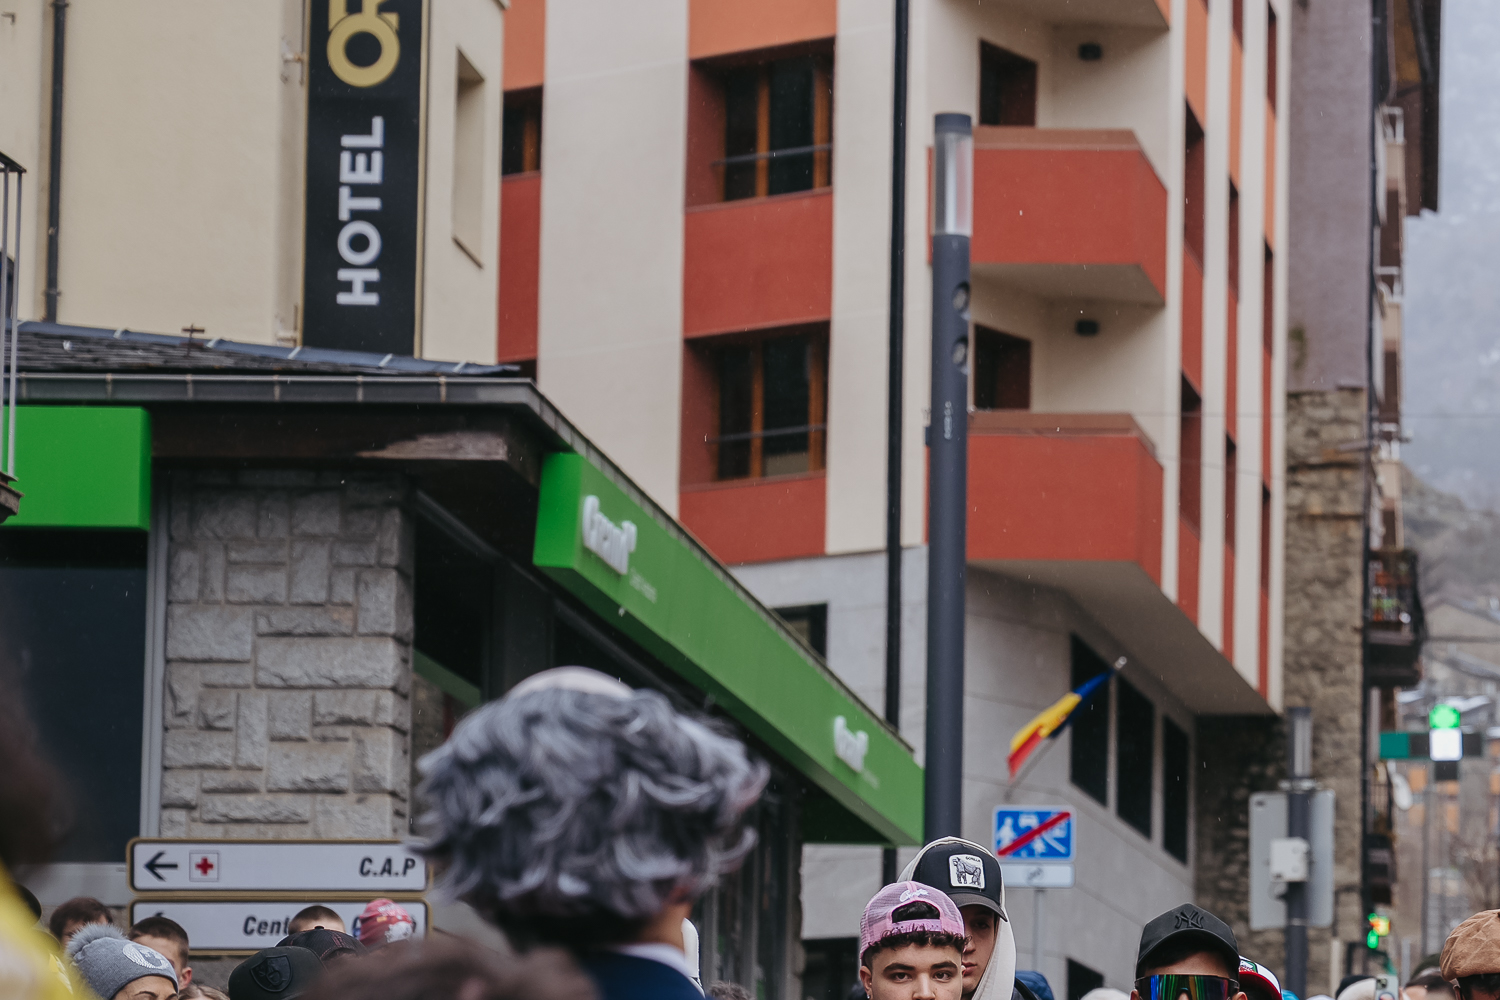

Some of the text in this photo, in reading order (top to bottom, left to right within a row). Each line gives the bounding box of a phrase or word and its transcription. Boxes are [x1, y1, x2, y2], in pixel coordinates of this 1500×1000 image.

[336, 115, 385, 306] HOTEL
[358, 856, 416, 878] C.A.P
[242, 915, 291, 937] Cent
[1174, 909, 1204, 930] NY
